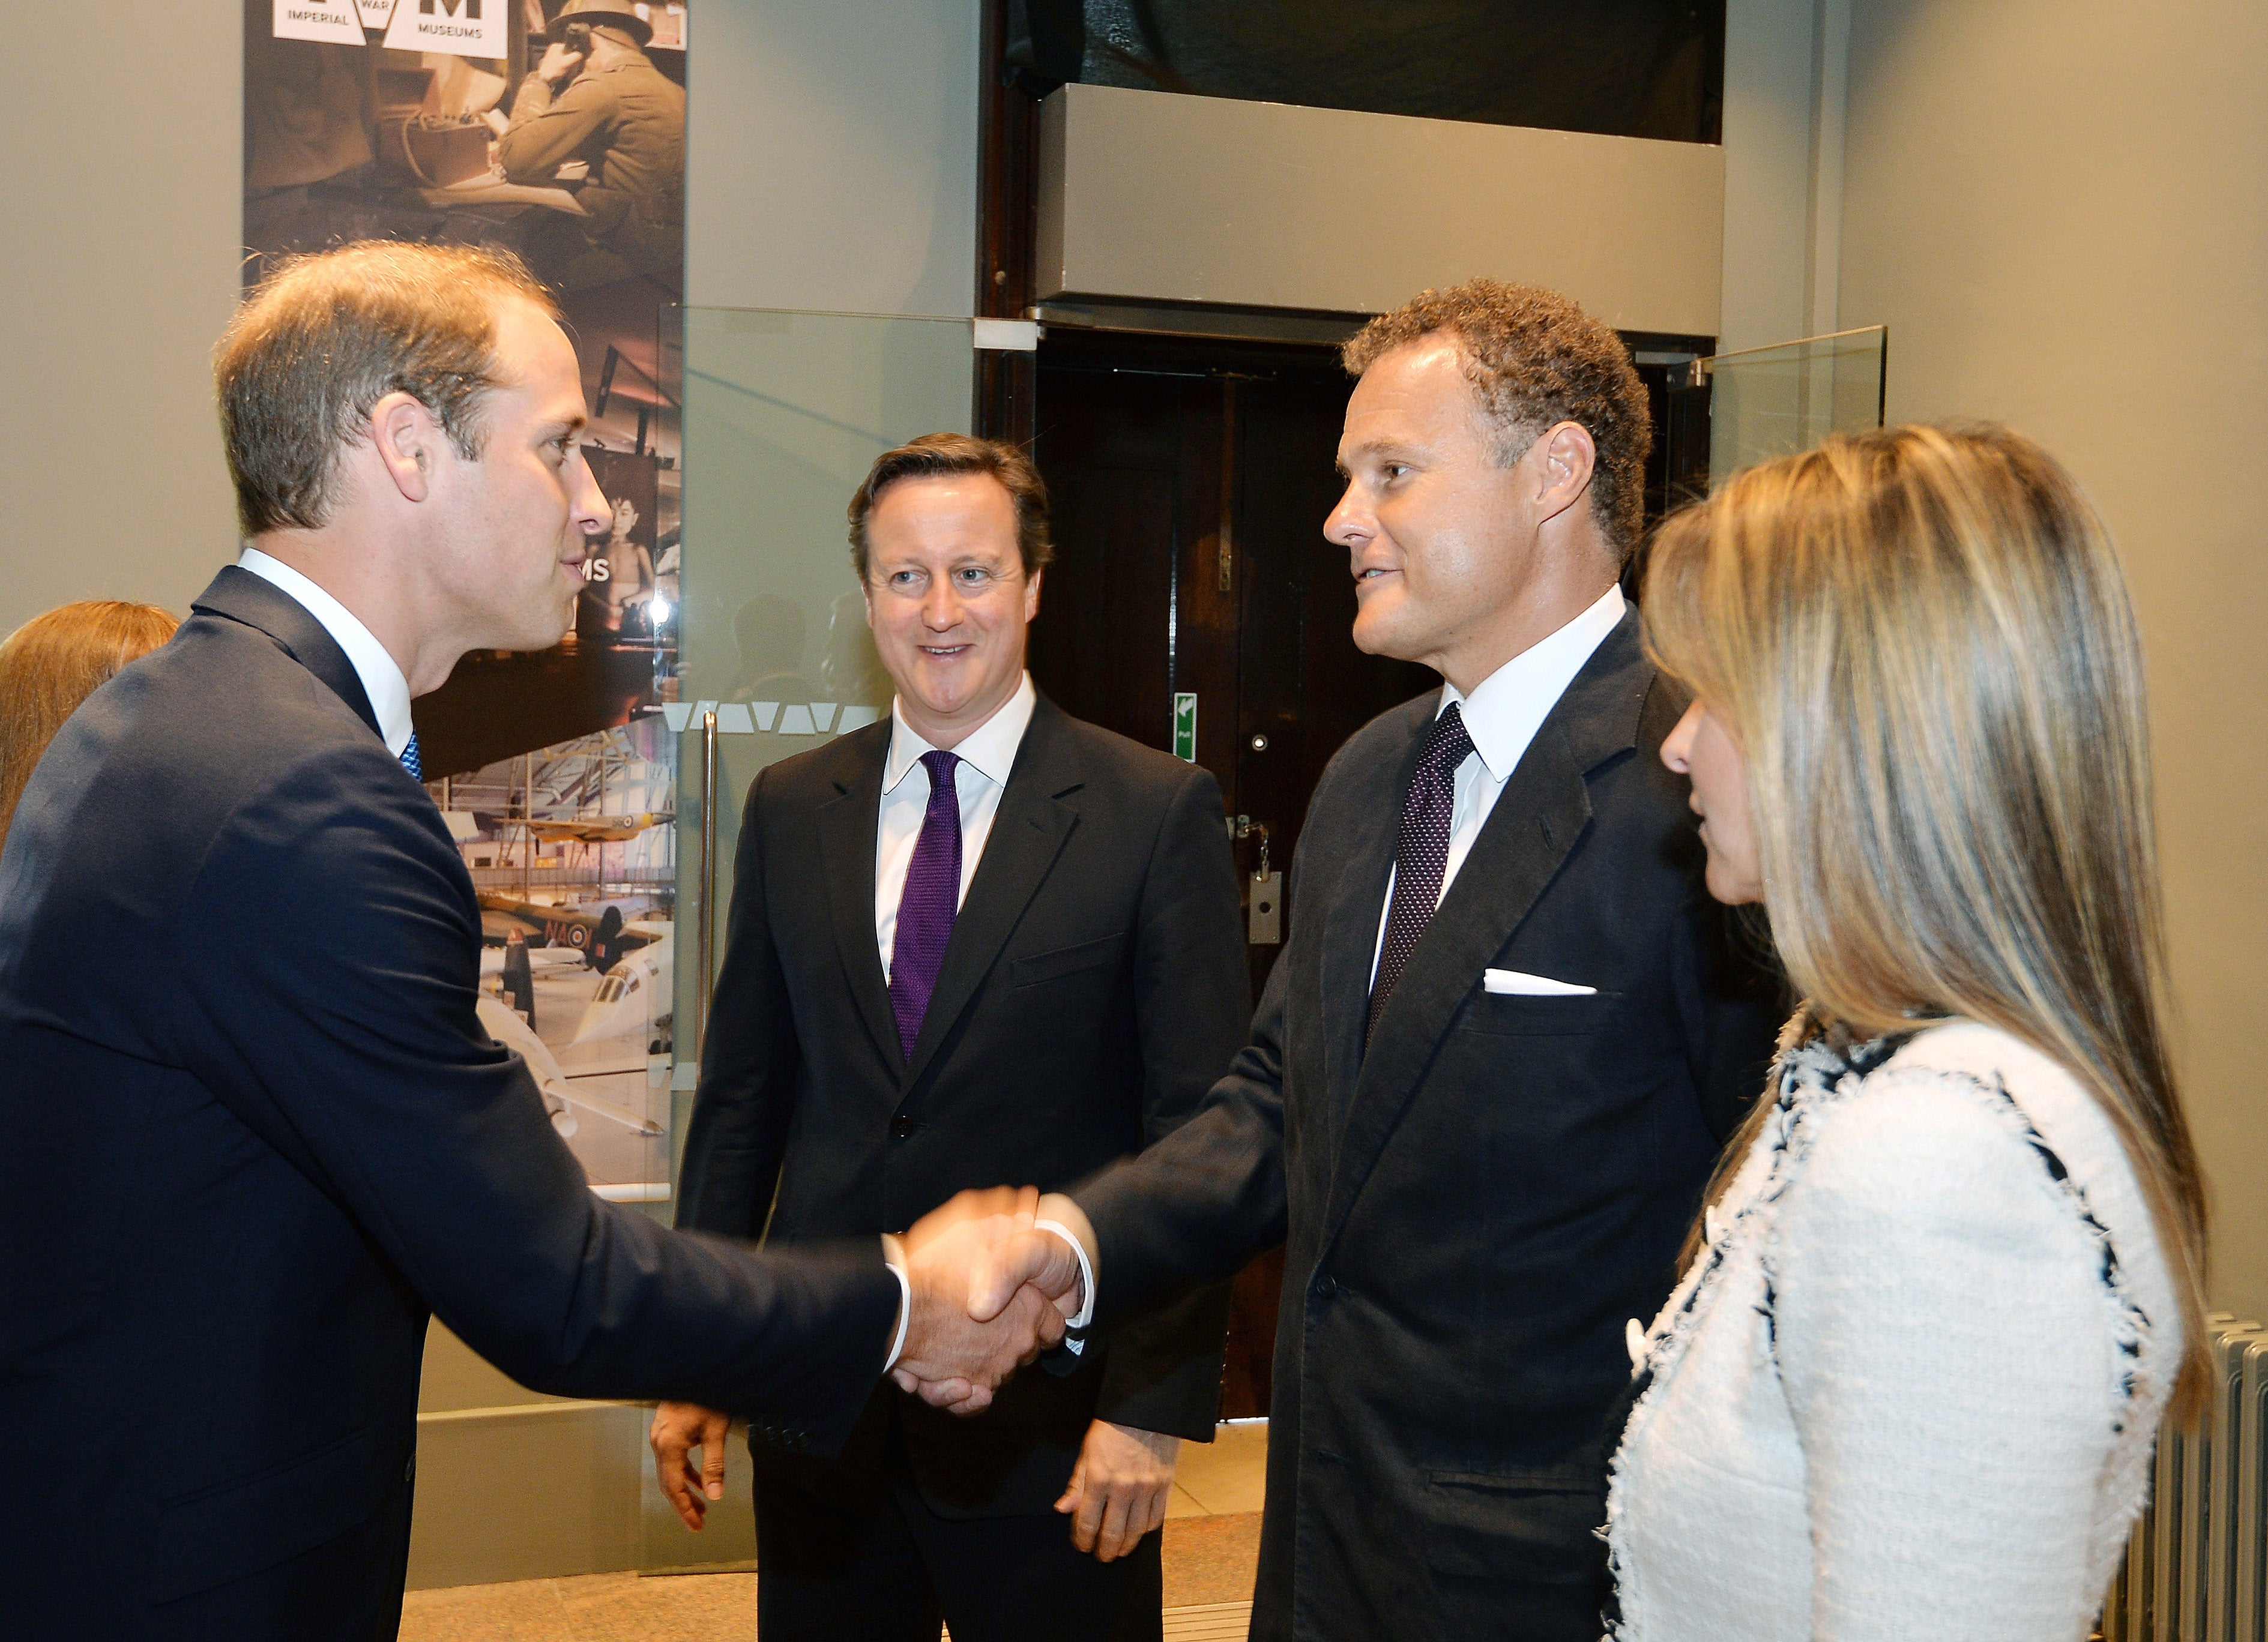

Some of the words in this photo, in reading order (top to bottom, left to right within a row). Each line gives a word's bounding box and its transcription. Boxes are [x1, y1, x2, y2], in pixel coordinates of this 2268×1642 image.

[363, 0, 389, 10] WAR
[288, 9, 350, 25] IMPERIAL
[418, 23, 483, 38] MUSEUMS
